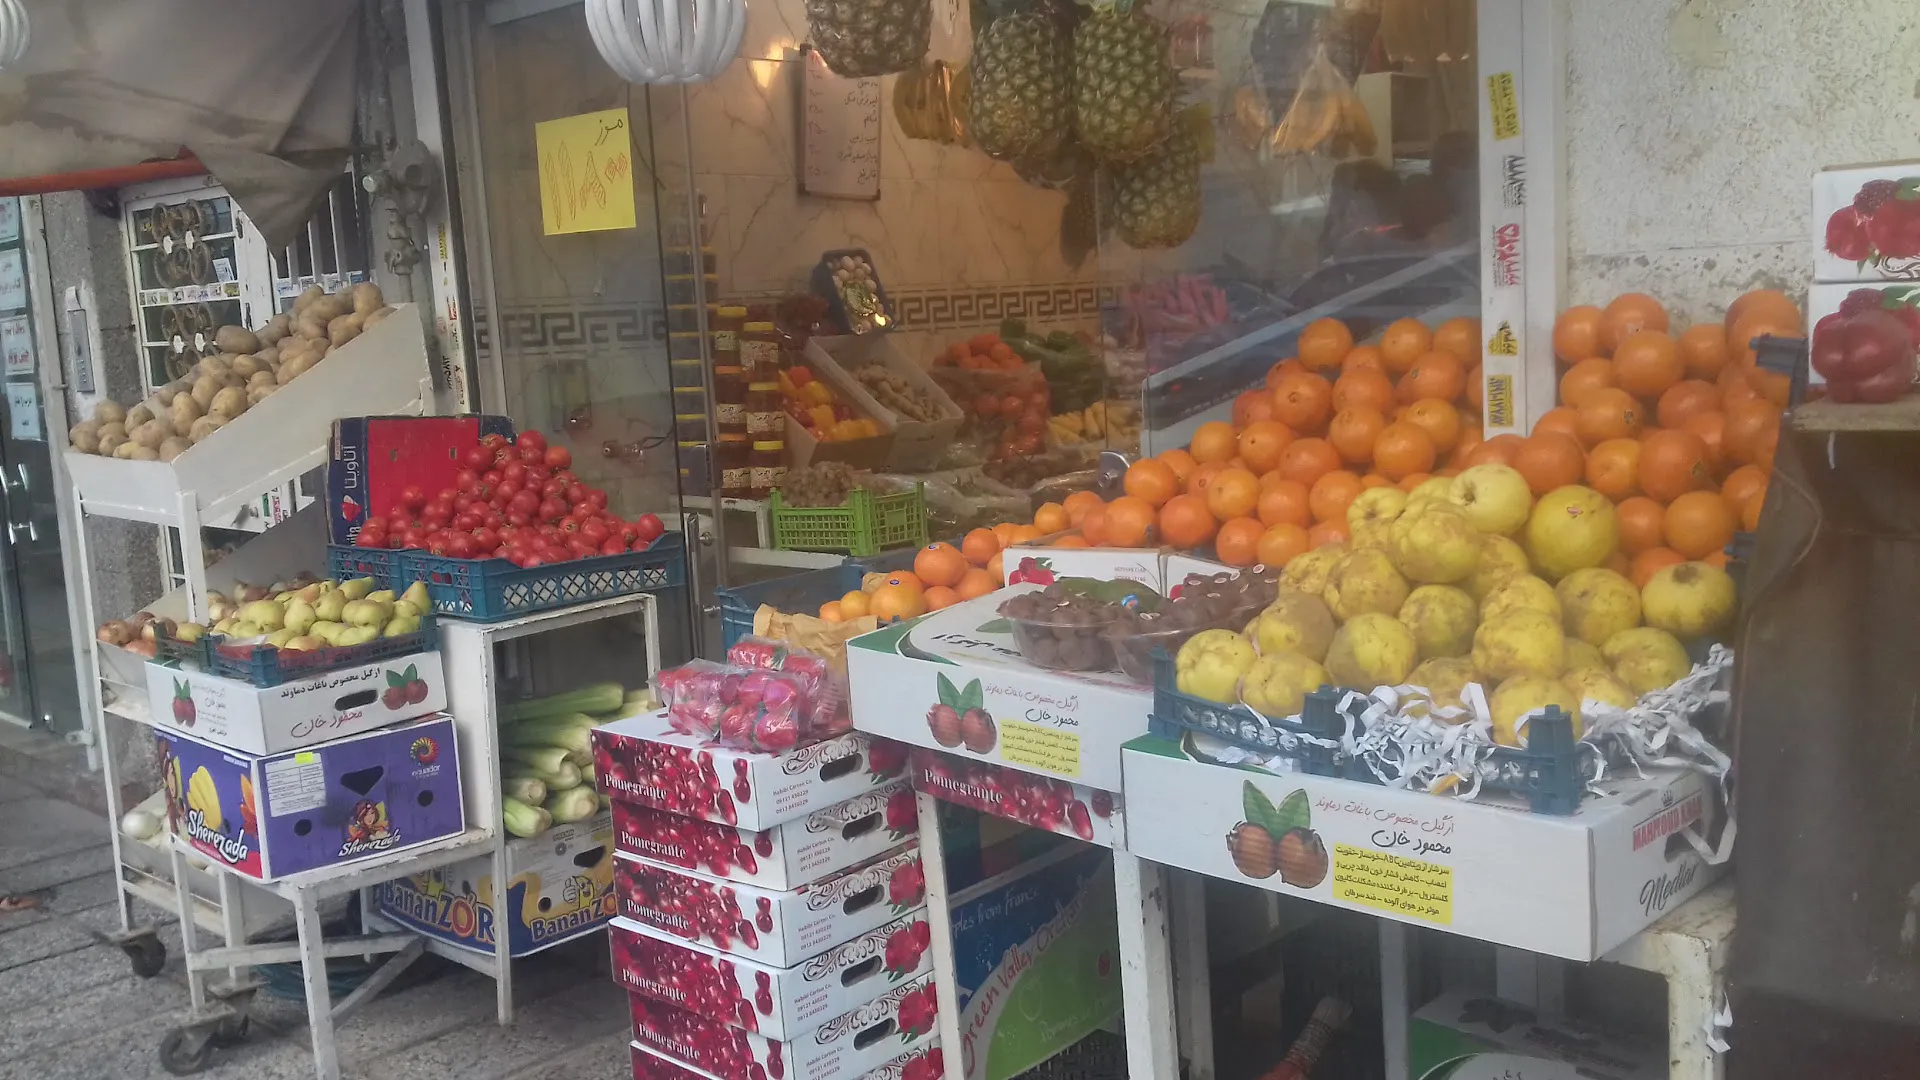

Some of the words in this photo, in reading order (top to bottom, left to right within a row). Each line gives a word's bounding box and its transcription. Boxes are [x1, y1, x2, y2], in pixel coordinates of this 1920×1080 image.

[594, 119, 623, 146] موز
[329, 674, 359, 689] مخصوص
[361, 667, 381, 681] ازگیل
[281, 686, 305, 699] دماوند
[307, 680, 327, 693] باغات
[985, 683, 1003, 694] دماوند
[1005, 686, 1023, 701] باغات
[1025, 692, 1055, 704] مخصوص
[1056, 695, 1079, 712] ازگیل
[1025, 707, 1051, 722] خان
[1053, 715, 1079, 728] محمود
[291, 715, 327, 738] خان
[604, 773, 667, 800] Pomegrante
[789, 782, 805, 791] Carton
[924, 769, 1003, 804] Pomegrante
[1315, 796, 1341, 812] دماوند
[1344, 801, 1371, 820] باغات
[1374, 810, 1418, 825] مخصوص
[1421, 815, 1454, 836] ازگیل
[188, 810, 248, 863] Sherezada
[338, 829, 401, 857] Sherezada
[621, 831, 686, 859] Pomegrante
[1371, 830, 1411, 848] خان
[1413, 839, 1452, 856] محمود
[1370, 866, 1383, 876] خون
[1399, 875, 1420, 883] کاهش
[1425, 880, 1447, 888] اعصاب
[627, 899, 689, 931] Pomegrante
[977, 902, 1001, 925] from
[998, 943, 1033, 989] Valley
[622, 968, 687, 1002] Pomegrante
[638, 1023, 701, 1060] Pomegrante
